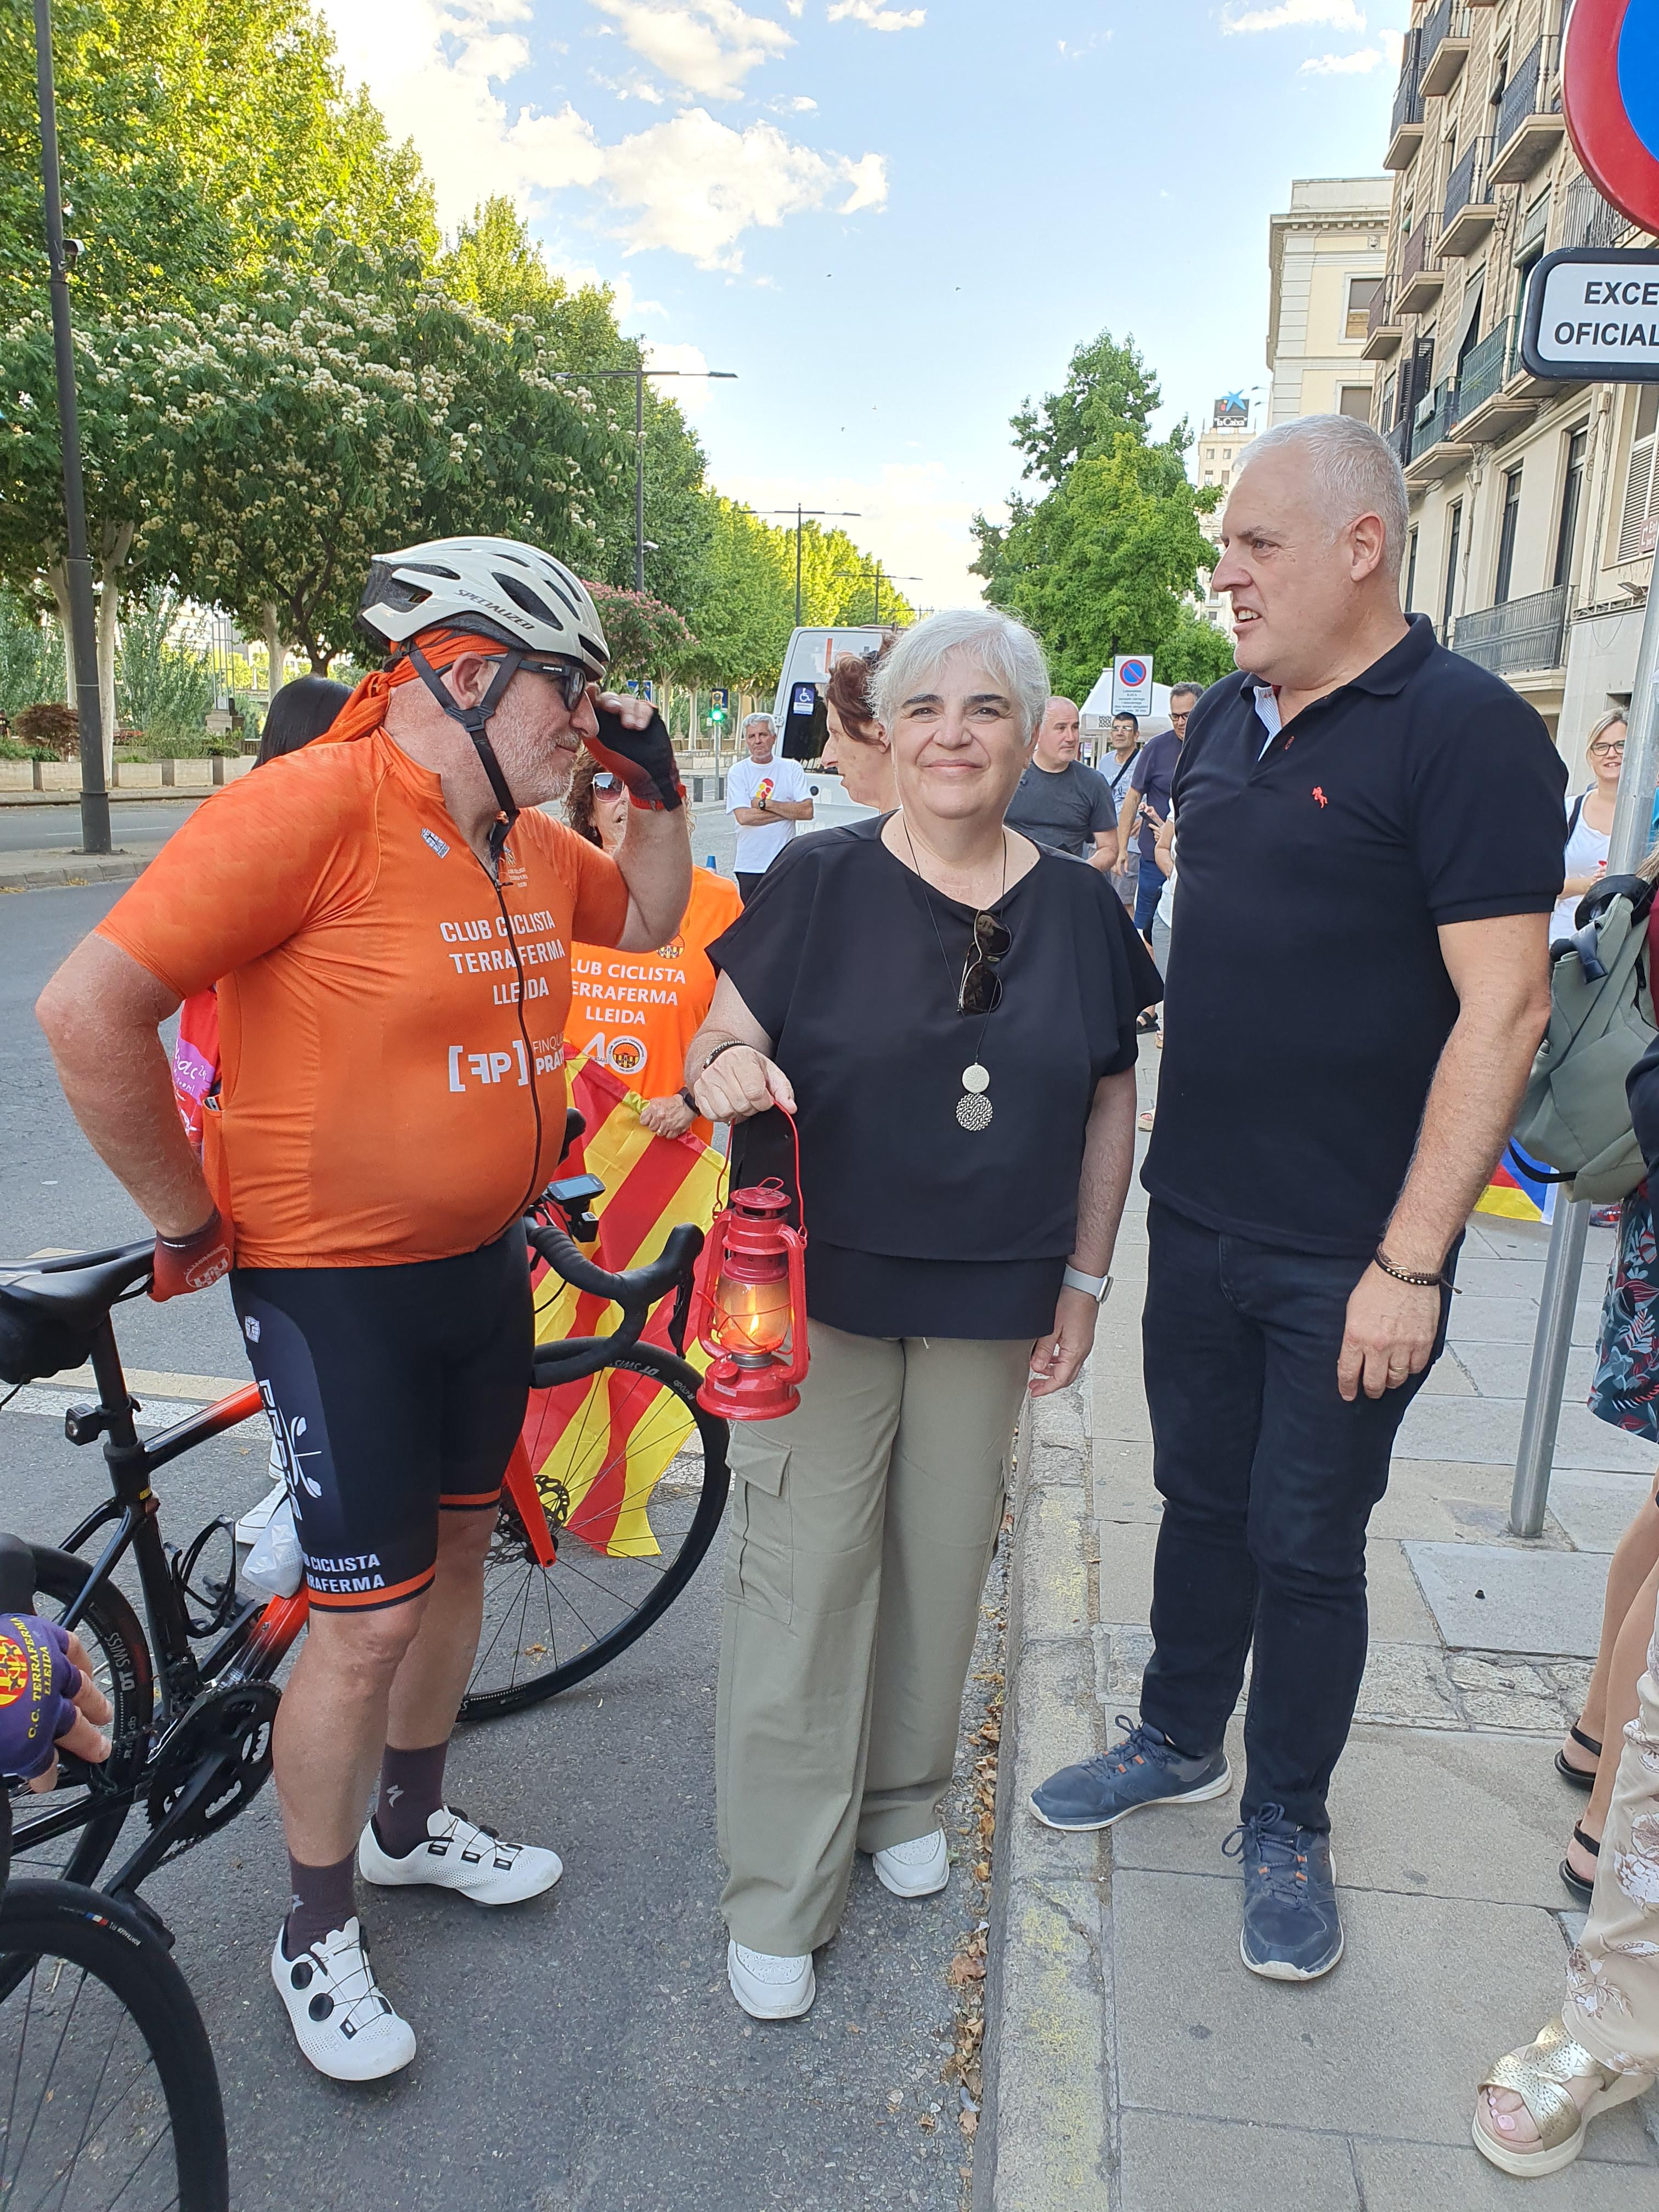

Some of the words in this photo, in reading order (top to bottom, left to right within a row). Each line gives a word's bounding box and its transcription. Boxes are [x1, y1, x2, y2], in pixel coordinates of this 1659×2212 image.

[1584, 281, 1659, 305] EXCE
[1555, 322, 1659, 346] OFICIAL
[453, 588, 536, 630] SPECIALIZED
[440, 919, 492, 943] CLUB
[495, 910, 556, 937] CICLISTA
[449, 939, 566, 974] TERRAFERMA
[607, 964, 686, 985] CICLISTA
[493, 977, 549, 1005] LLEIDA
[586, 1006, 646, 1025] LLEIDA
[640, 1366, 659, 1376] DT
[310, 1553, 381, 1572] CICLISTA
[9, 1617, 42, 1701] TERRAFERMA
[105, 1632, 130, 1668] SWISS
[41, 1646, 53, 1696] LLEIDA
[118, 1671, 137, 1691] DT
